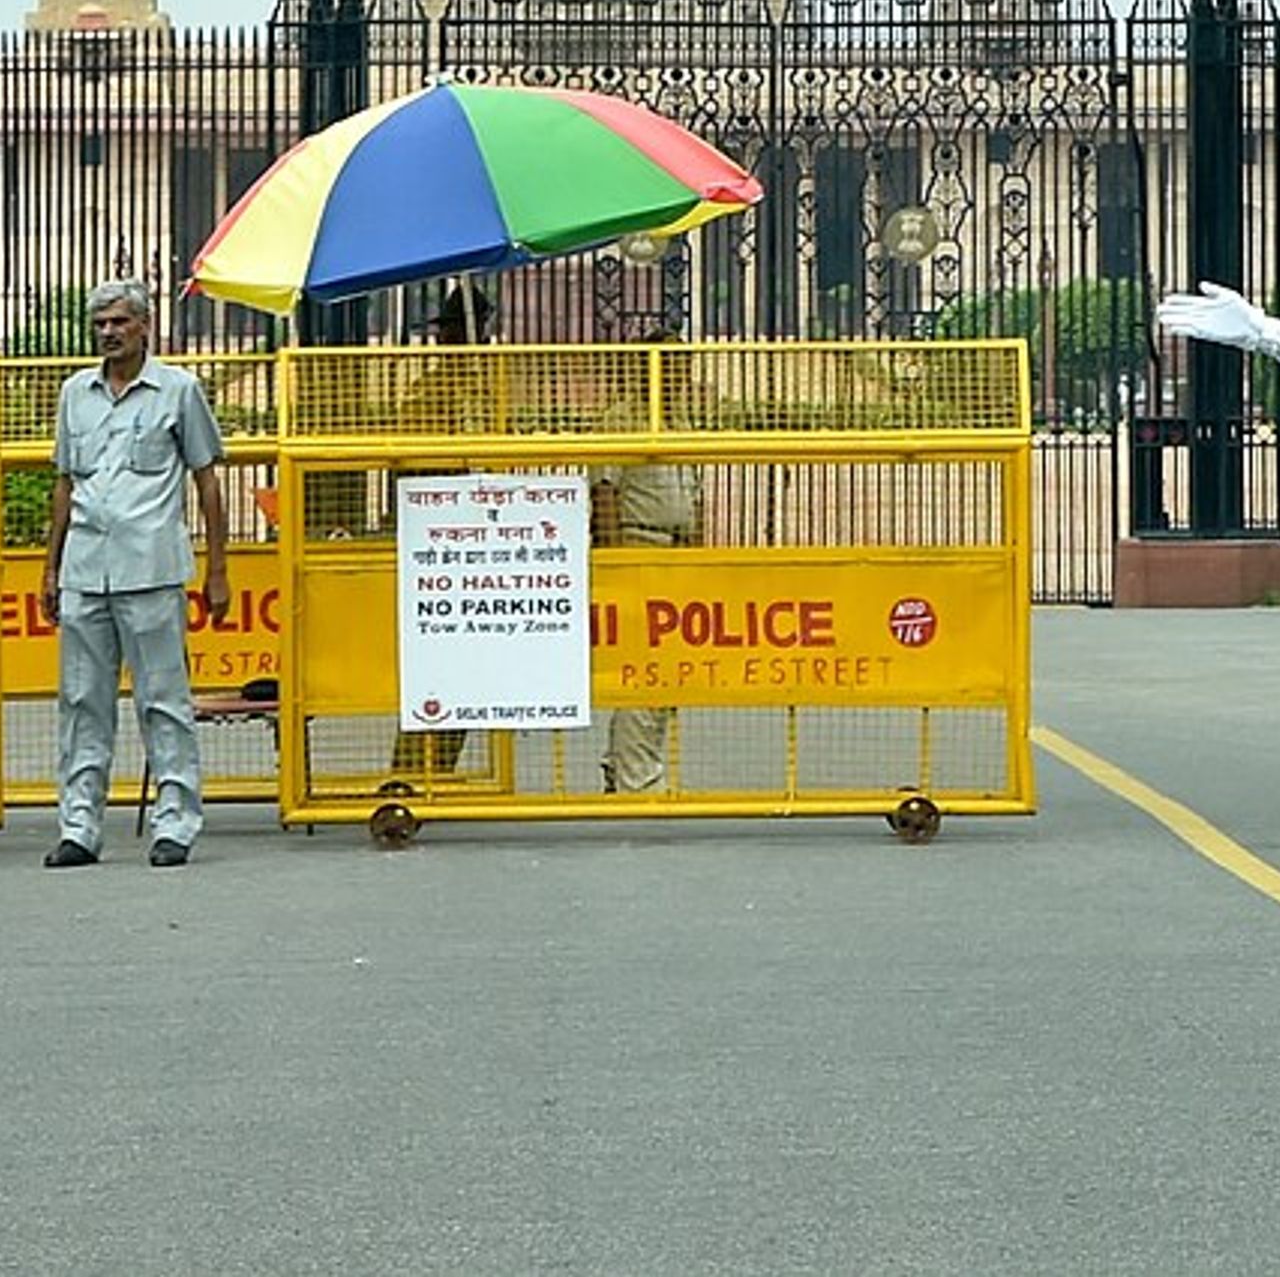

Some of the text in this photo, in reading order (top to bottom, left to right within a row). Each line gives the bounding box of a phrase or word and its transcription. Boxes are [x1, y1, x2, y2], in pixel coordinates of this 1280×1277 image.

[407, 489, 459, 506] वाहन
[524, 488, 577, 504] करना
[497, 526, 533, 541] मना
[540, 520, 558, 540] है
[418, 574, 572, 591] NO HALTING
[185, 588, 280, 634] OLIC
[418, 598, 572, 617] NO PARKING
[418, 620, 571, 636] Tow Away Zone
[645, 600, 836, 648] POLICE
[218, 651, 282, 676] STR
[539, 704, 579, 718] POLICE
